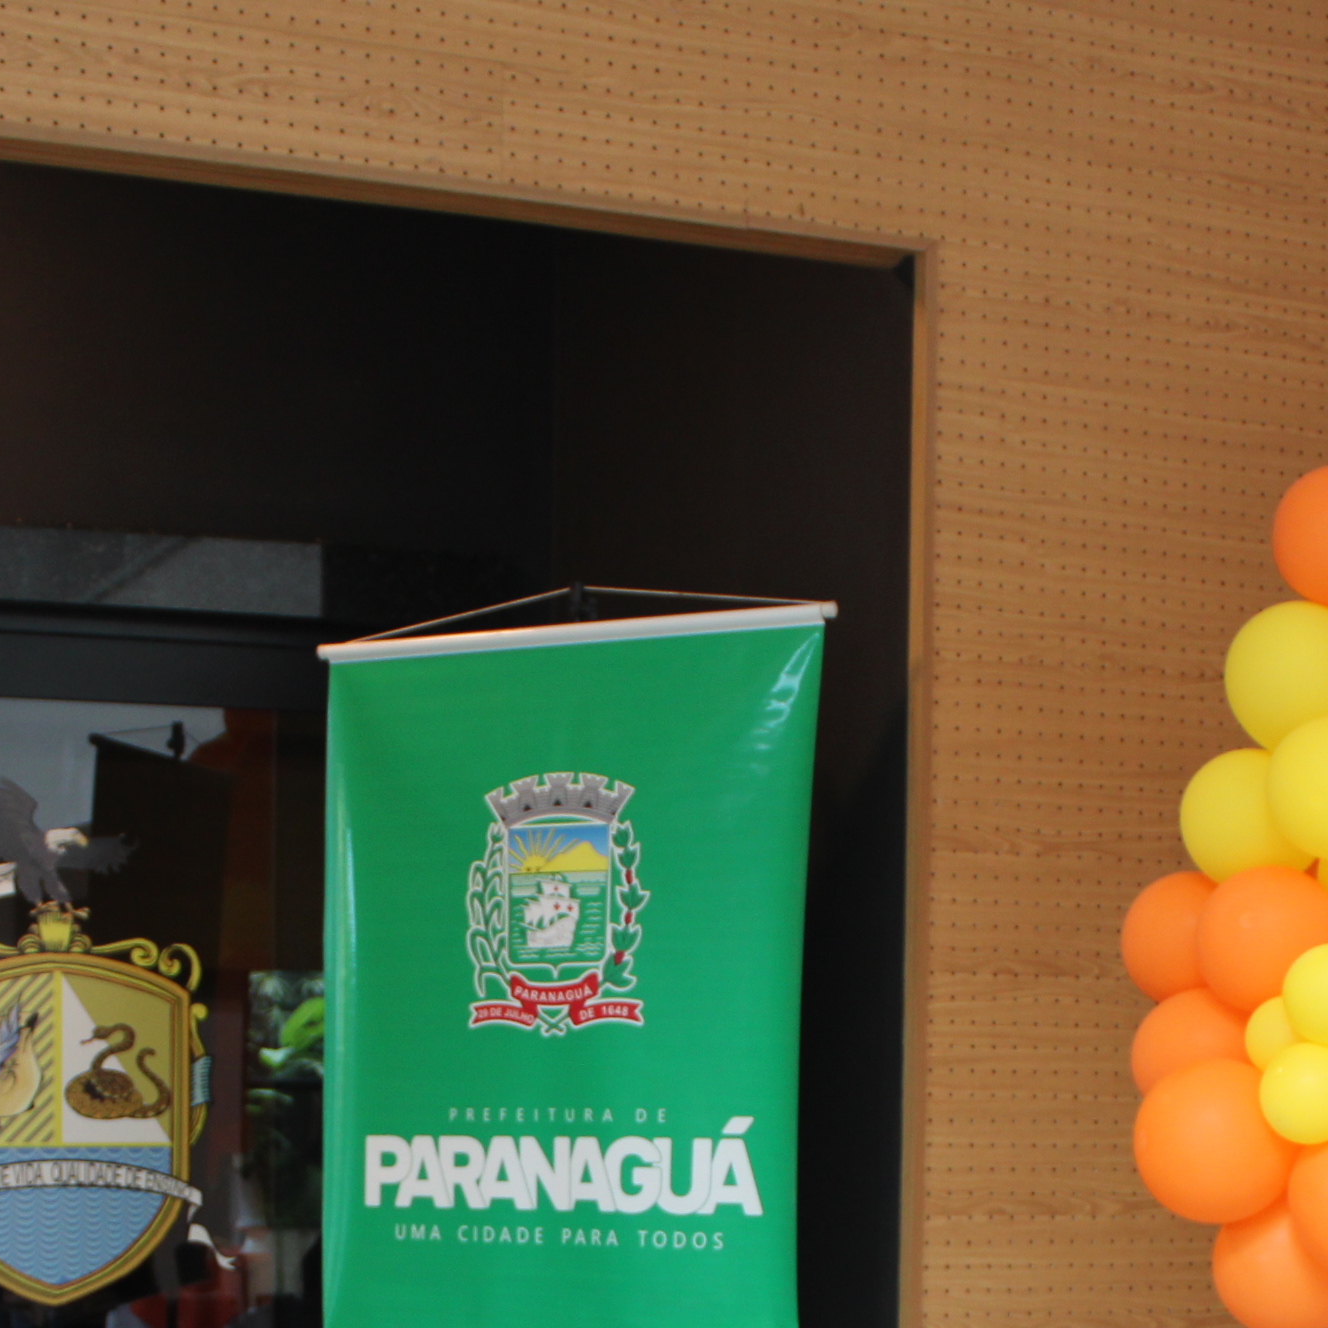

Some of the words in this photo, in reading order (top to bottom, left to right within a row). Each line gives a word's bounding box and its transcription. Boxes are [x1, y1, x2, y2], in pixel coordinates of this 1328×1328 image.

[515, 984, 592, 1001] PARANAGUÁ
[580, 1008, 595, 1020] DE
[448, 1107, 615, 1123] PREFEITURA
[635, 1108, 668, 1123] DE
[14, 1161, 44, 1186] VIDA
[50, 1161, 126, 1187] QUALIDADE
[363, 1115, 764, 1217] PARANAGUÁ
[394, 1223, 442, 1241] UMA
[457, 1225, 544, 1245] CIDADE
[561, 1228, 620, 1247] PARA
[638, 1230, 725, 1250] TODOS
